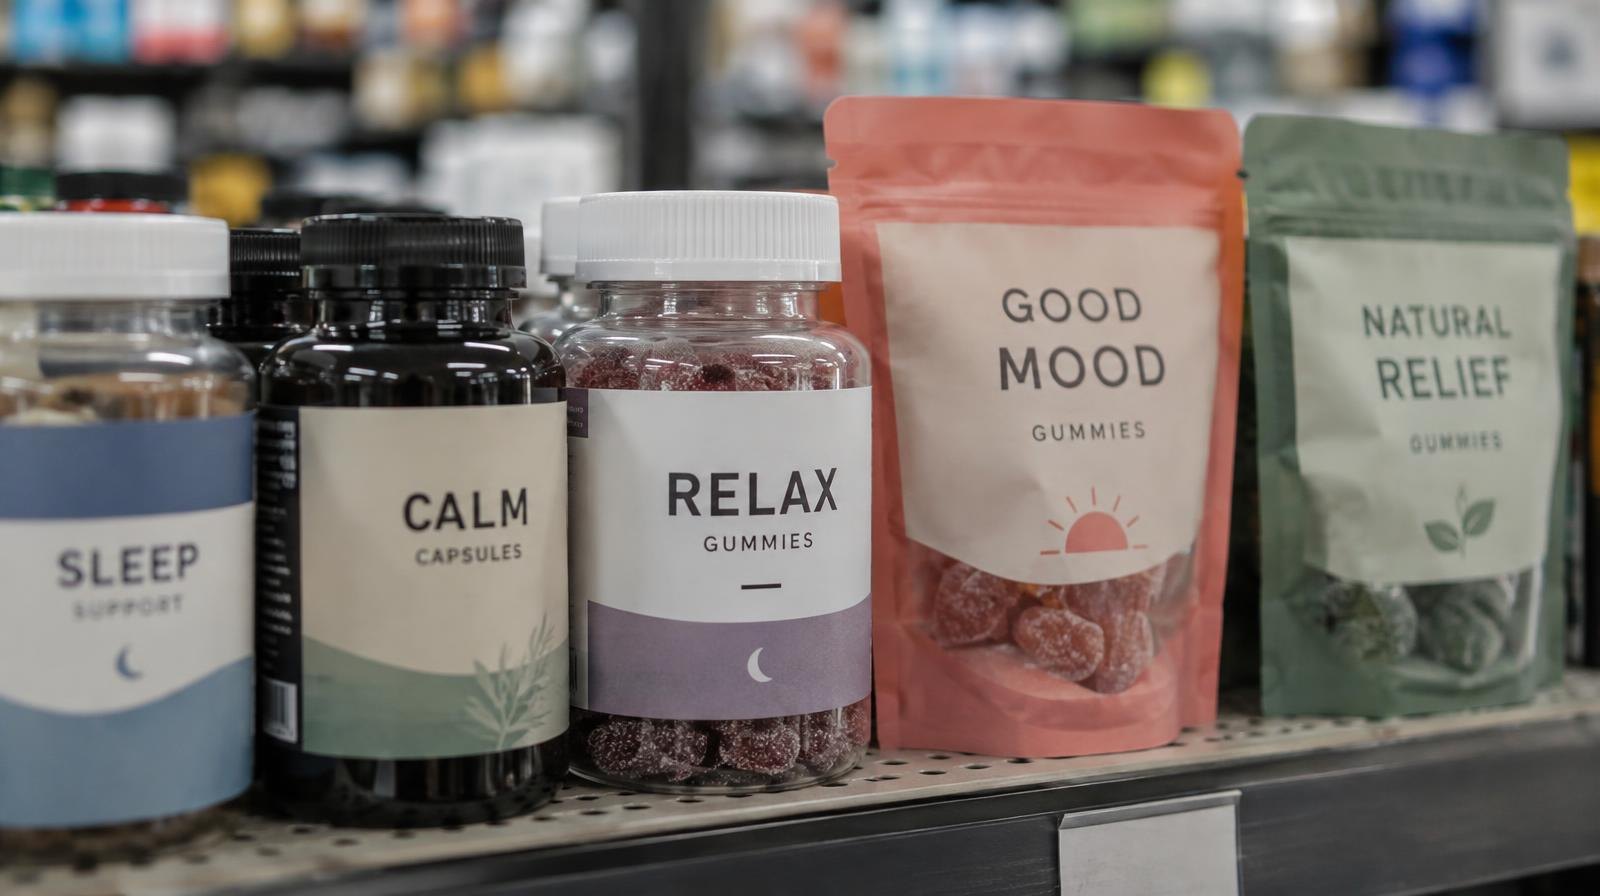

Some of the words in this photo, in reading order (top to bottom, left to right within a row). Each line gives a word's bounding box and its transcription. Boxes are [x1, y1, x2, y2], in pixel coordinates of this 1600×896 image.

[1002, 288, 1141, 323] GOOD
[1362, 304, 1511, 339] NATURAL
[999, 345, 1165, 390] MOOD
[1376, 356, 1510, 400] RELIEF
[1032, 421, 1146, 442] GUMMIES
[1409, 431, 1503, 454] GUMMIES
[668, 467, 838, 517] RELAX
[403, 487, 529, 533] CALM
[415, 543, 524, 566] CAPSULES
[703, 532, 814, 552] GUMMIES
[57, 541, 200, 589] SLEEP
[73, 593, 183, 621] SUPPORT
